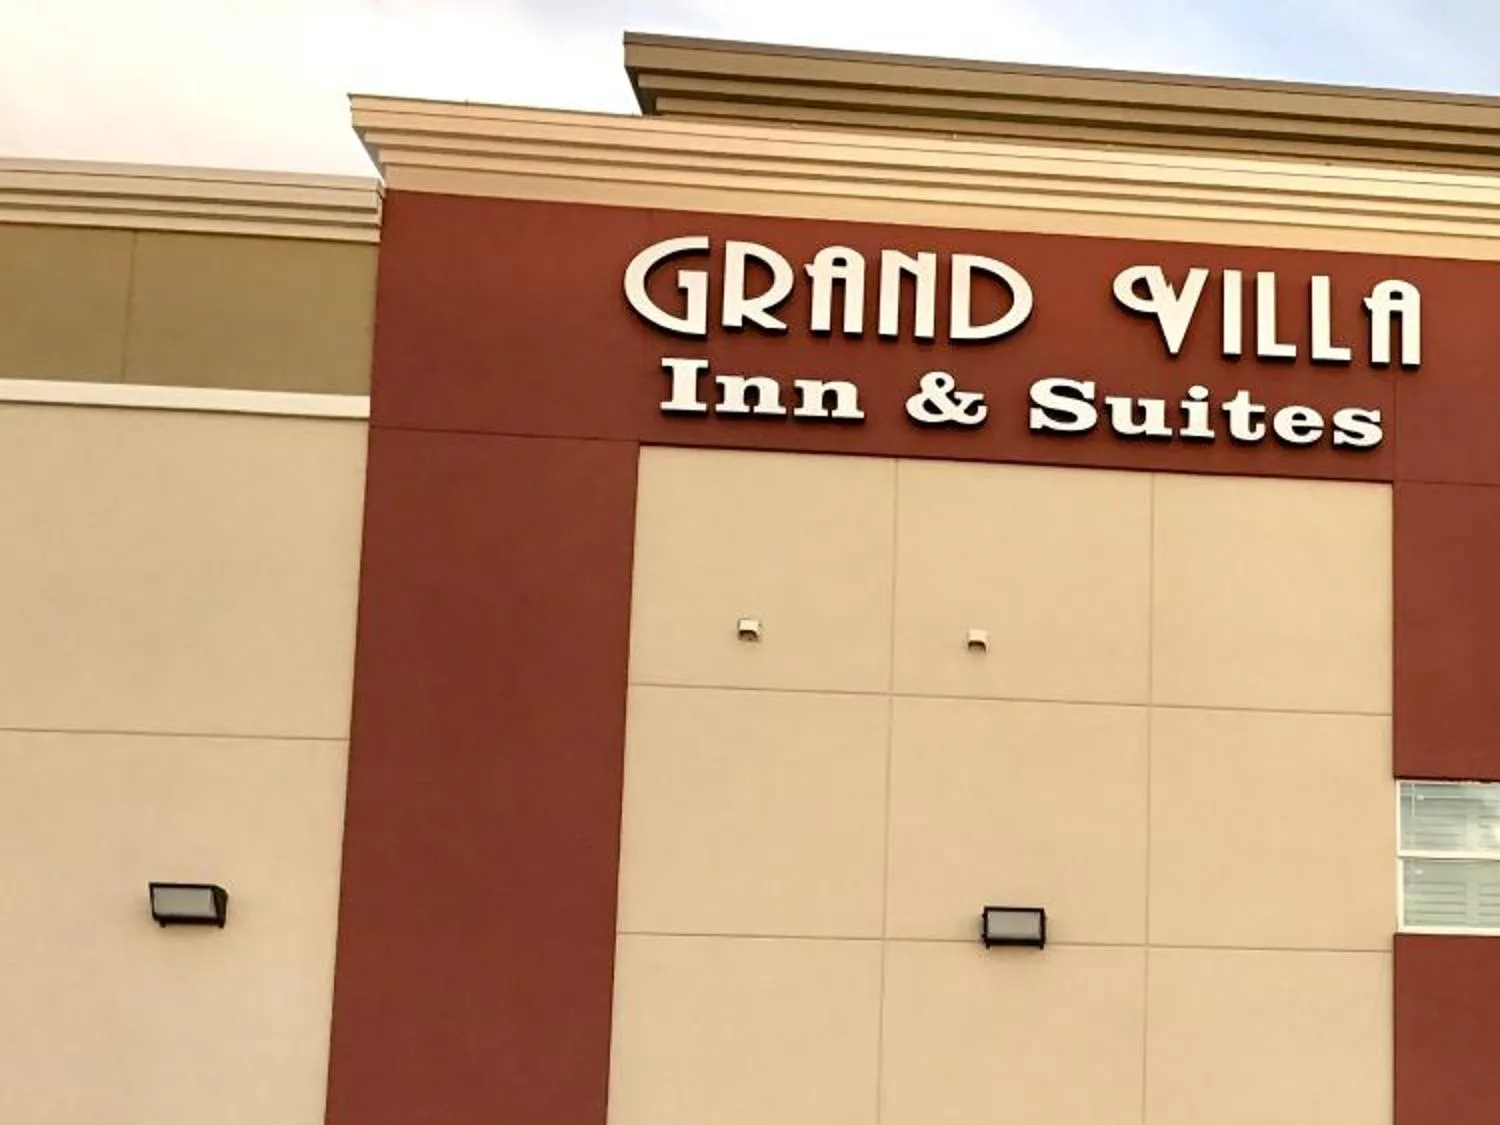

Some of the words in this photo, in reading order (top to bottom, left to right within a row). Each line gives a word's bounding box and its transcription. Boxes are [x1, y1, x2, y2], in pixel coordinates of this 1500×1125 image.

[624, 236, 1033, 339] GRAND
[1114, 265, 1421, 365] VILLA
[660, 357, 865, 418] Inn
[906, 371, 987, 425] &
[1030, 377, 1383, 446] Suites
